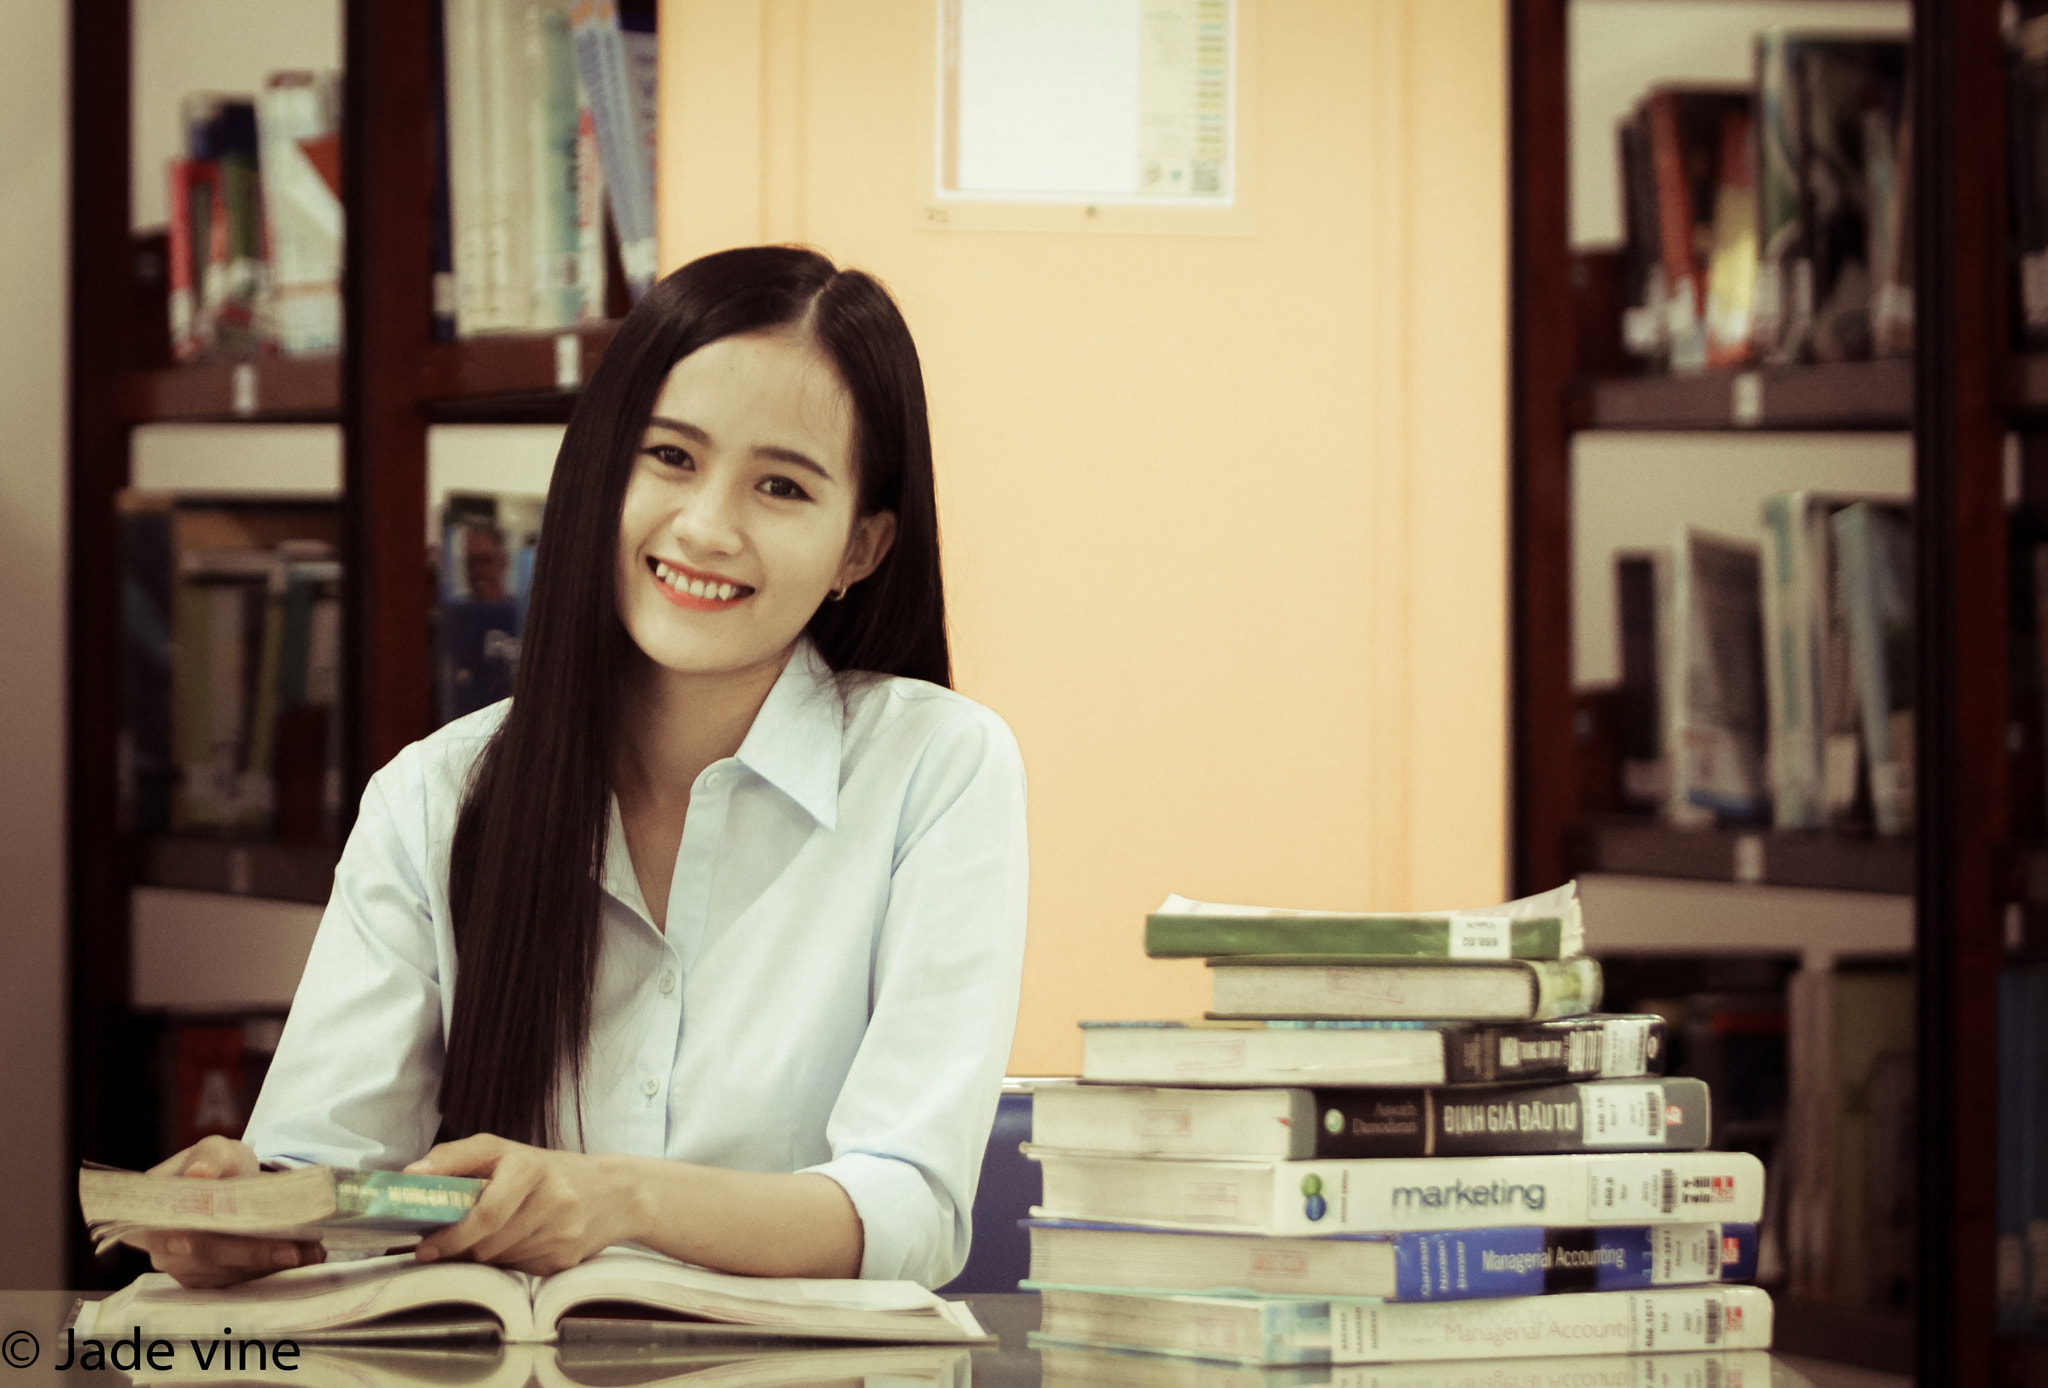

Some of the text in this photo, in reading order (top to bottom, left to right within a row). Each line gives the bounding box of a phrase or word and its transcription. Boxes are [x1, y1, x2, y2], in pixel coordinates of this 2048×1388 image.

[1392, 1178, 1546, 1210] marketing
[1482, 1246, 1553, 1275] Managerial
[1555, 1243, 1626, 1269] Accounting
